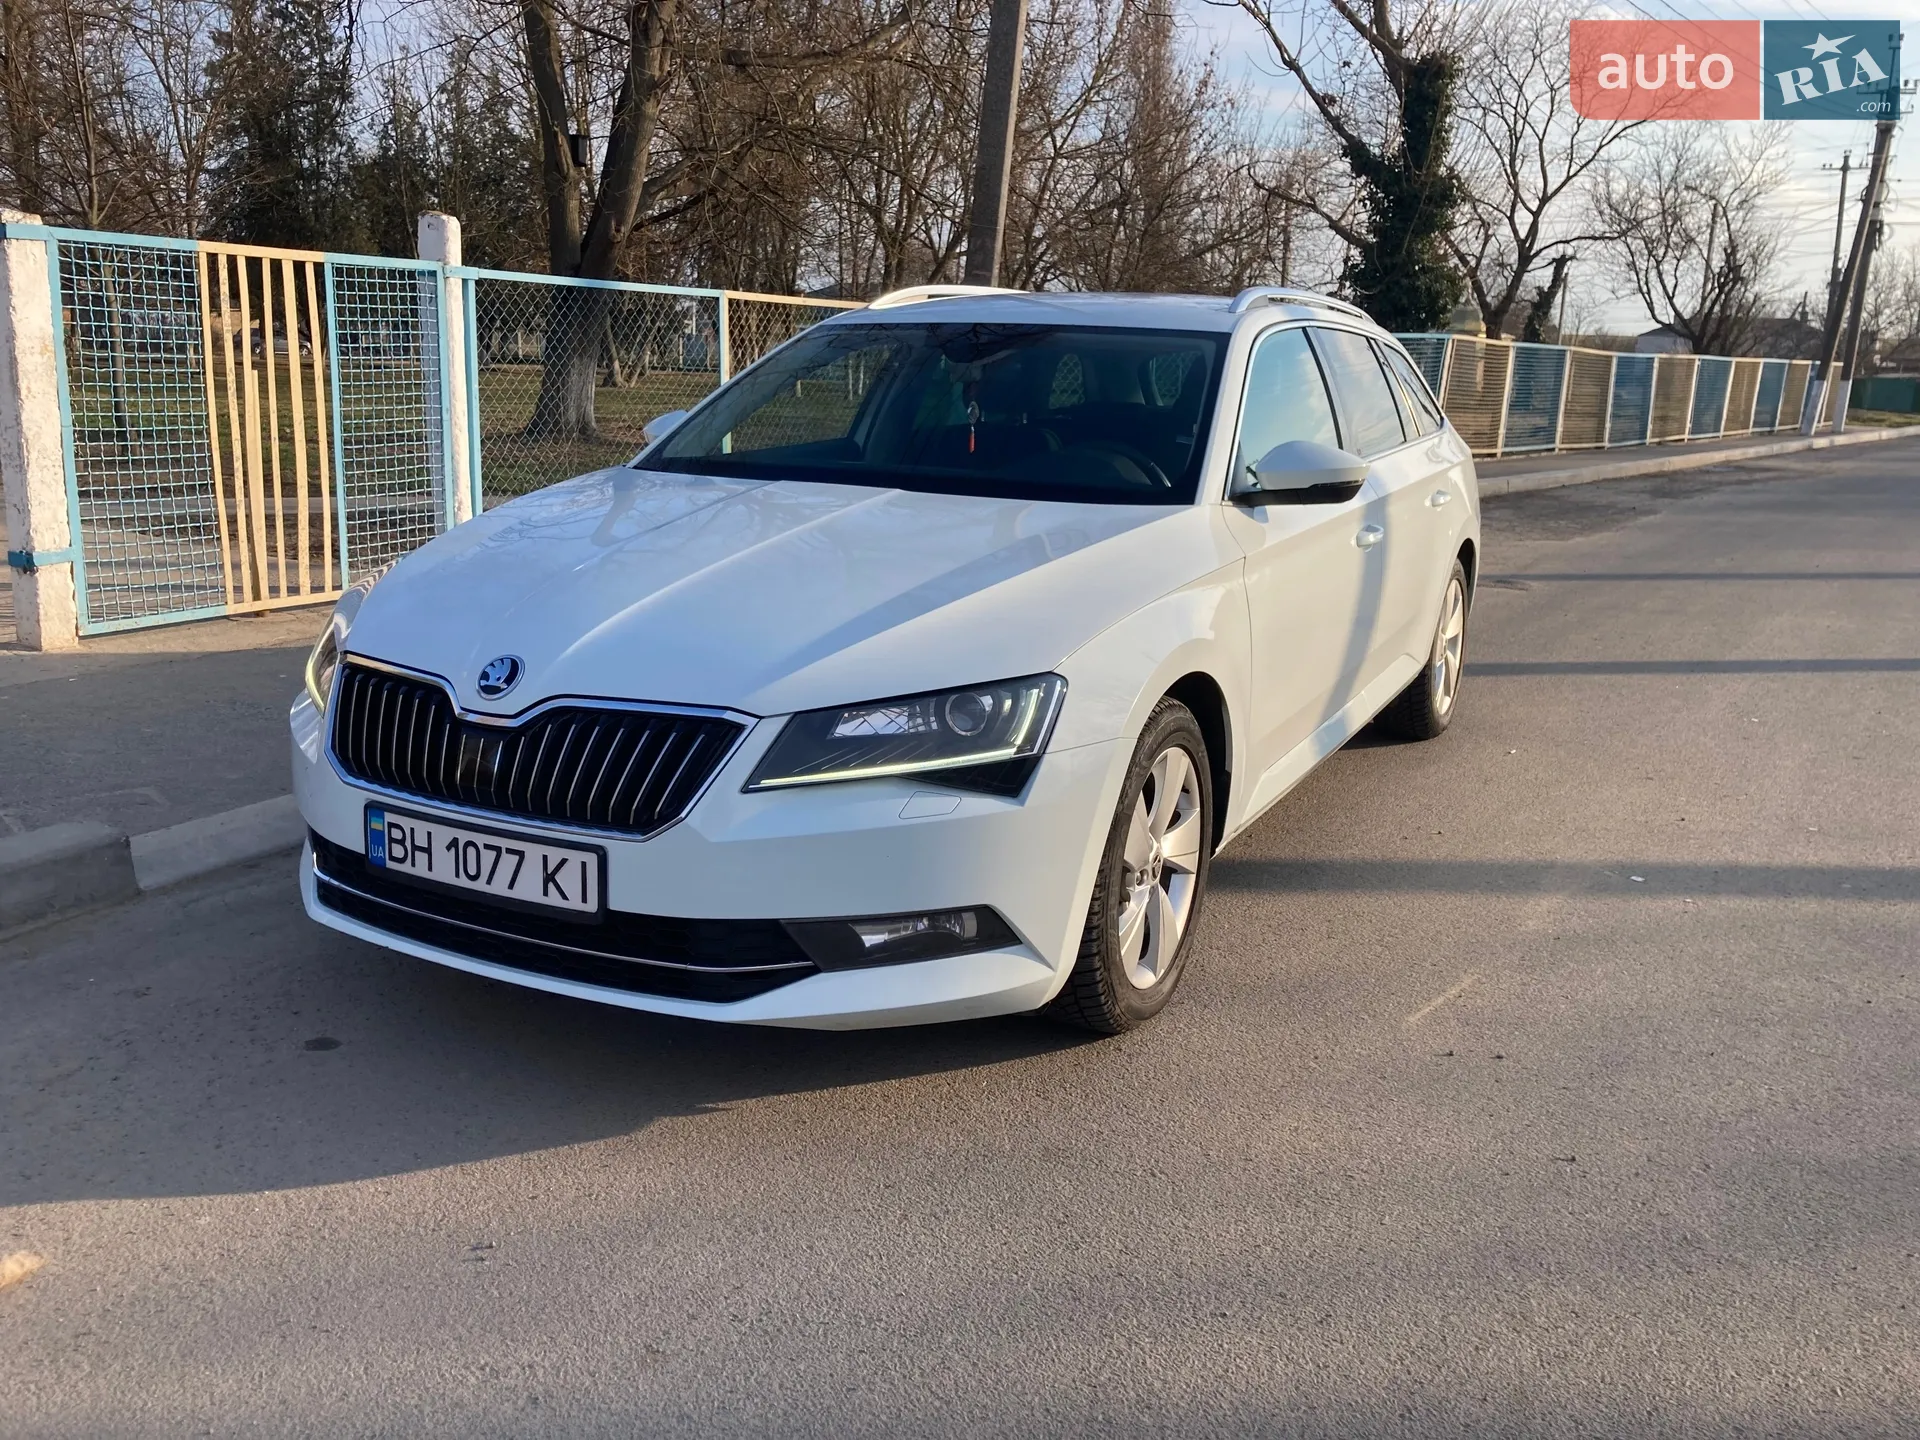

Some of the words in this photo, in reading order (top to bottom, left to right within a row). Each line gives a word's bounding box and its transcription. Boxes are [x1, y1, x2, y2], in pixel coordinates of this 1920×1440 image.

[371, 844, 385, 858] UA
[387, 821, 433, 872] BH
[445, 836, 526, 890] 1077
[542, 854, 588, 904] KI
